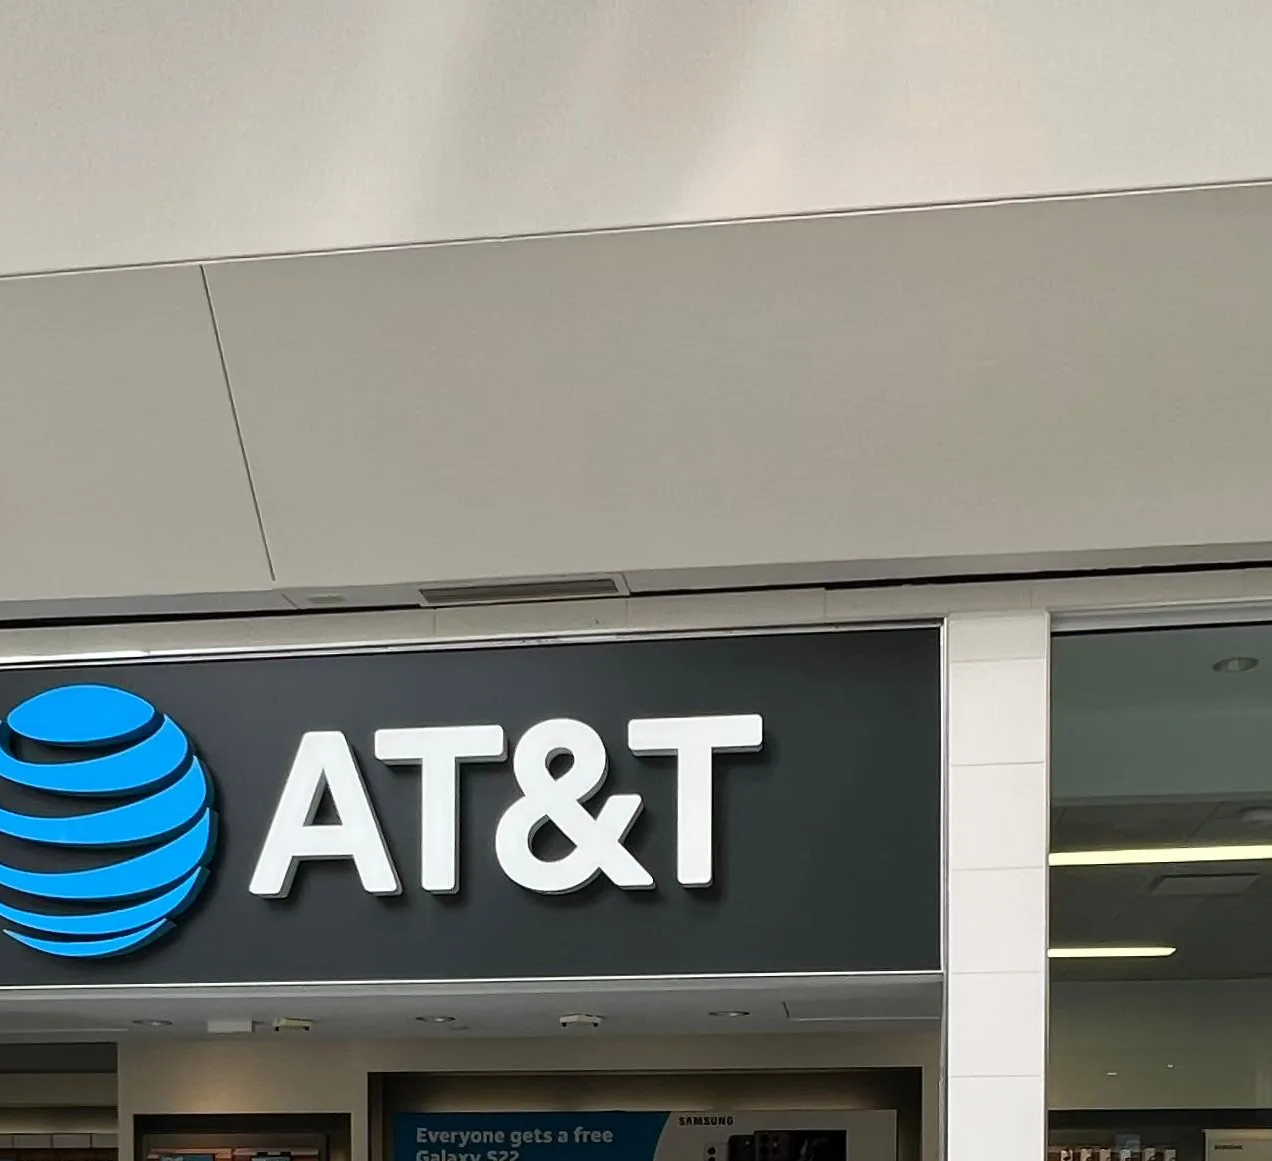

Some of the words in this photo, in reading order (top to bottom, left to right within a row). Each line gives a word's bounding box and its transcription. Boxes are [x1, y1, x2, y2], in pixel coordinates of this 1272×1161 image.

[248, 712, 764, 898] AT&T
[678, 1116, 734, 1126] SAMSUNG
[416, 1127, 506, 1148] Everyone
[510, 1128, 553, 1148] gets
[557, 1131, 569, 1143] a
[574, 1126, 614, 1143] free
